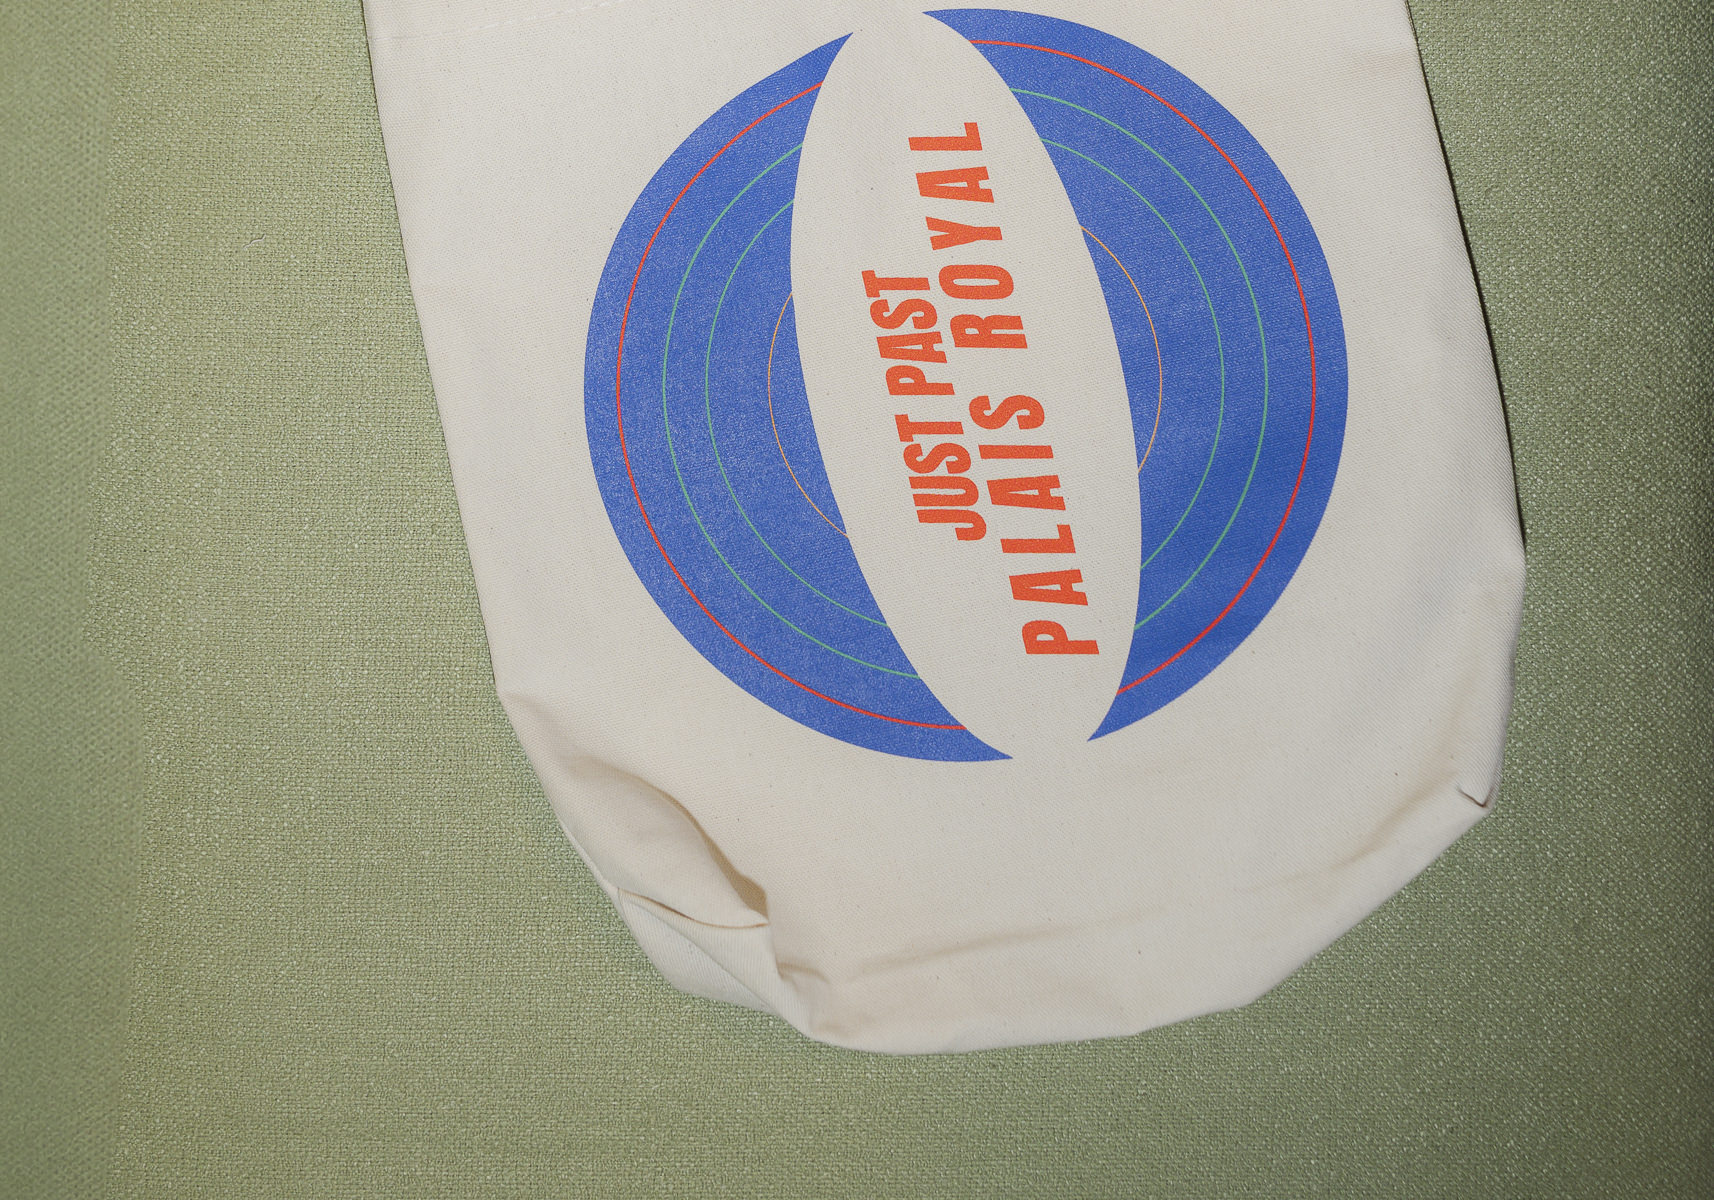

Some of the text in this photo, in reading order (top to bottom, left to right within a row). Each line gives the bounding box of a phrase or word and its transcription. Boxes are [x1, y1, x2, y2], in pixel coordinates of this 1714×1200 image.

[861, 269, 987, 542] JUST PAST
[908, 121, 1101, 655] PALAIS ROYAL
